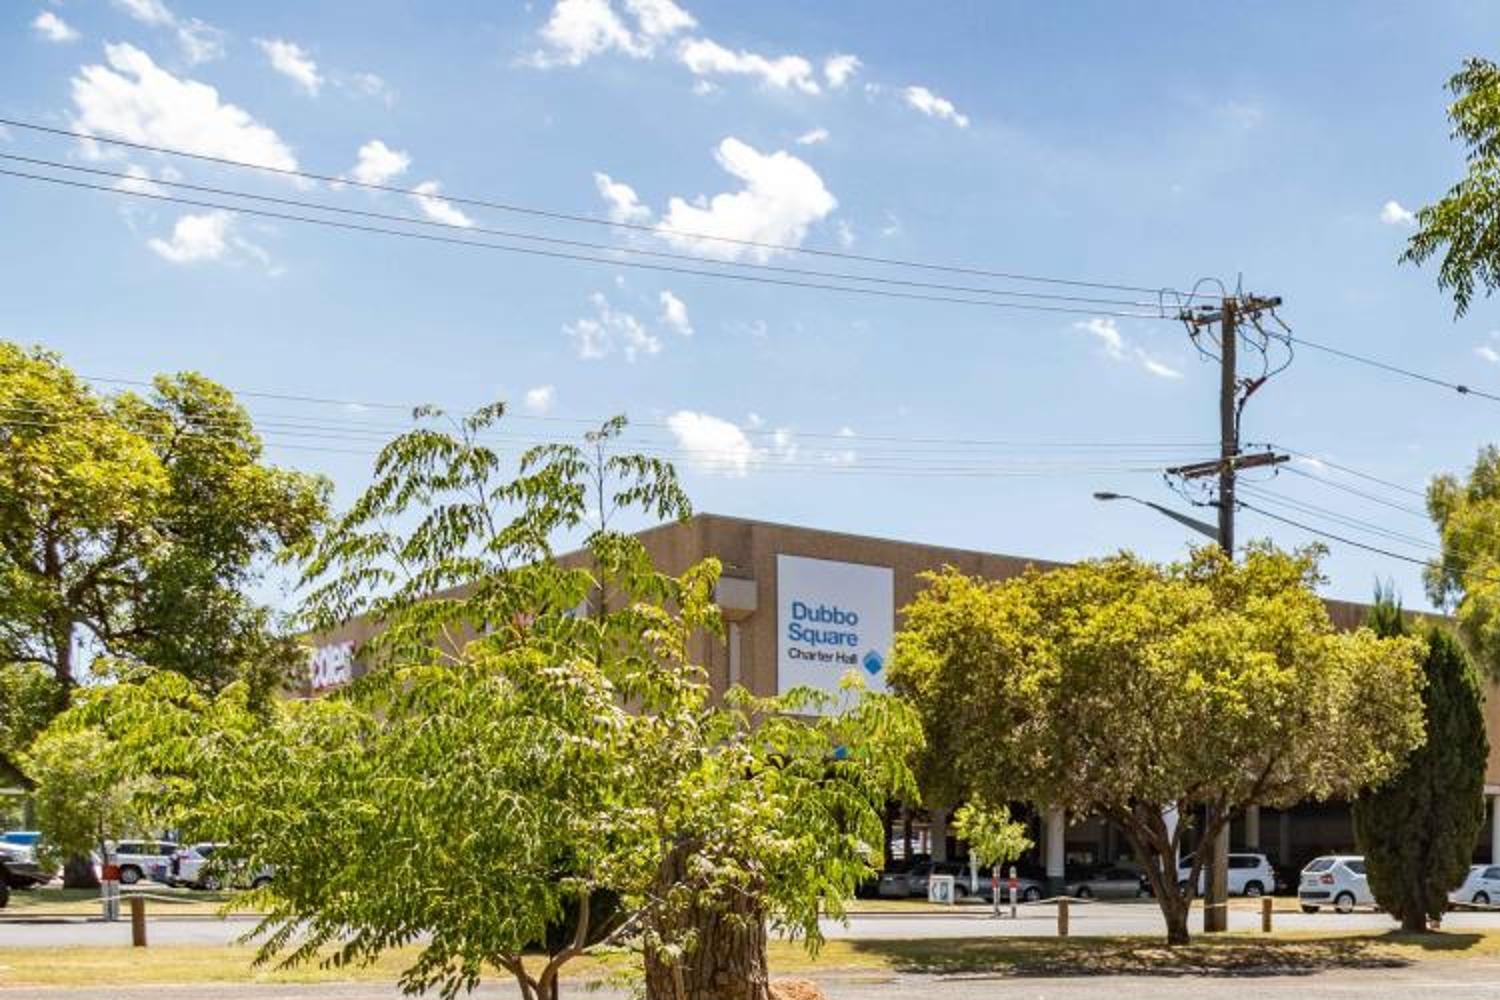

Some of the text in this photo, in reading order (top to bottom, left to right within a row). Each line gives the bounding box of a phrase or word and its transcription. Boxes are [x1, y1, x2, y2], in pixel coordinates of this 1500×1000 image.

[792, 601, 858, 626] Dubbo
[788, 622, 858, 647] Square
[788, 648, 858, 664] Charter Hall
